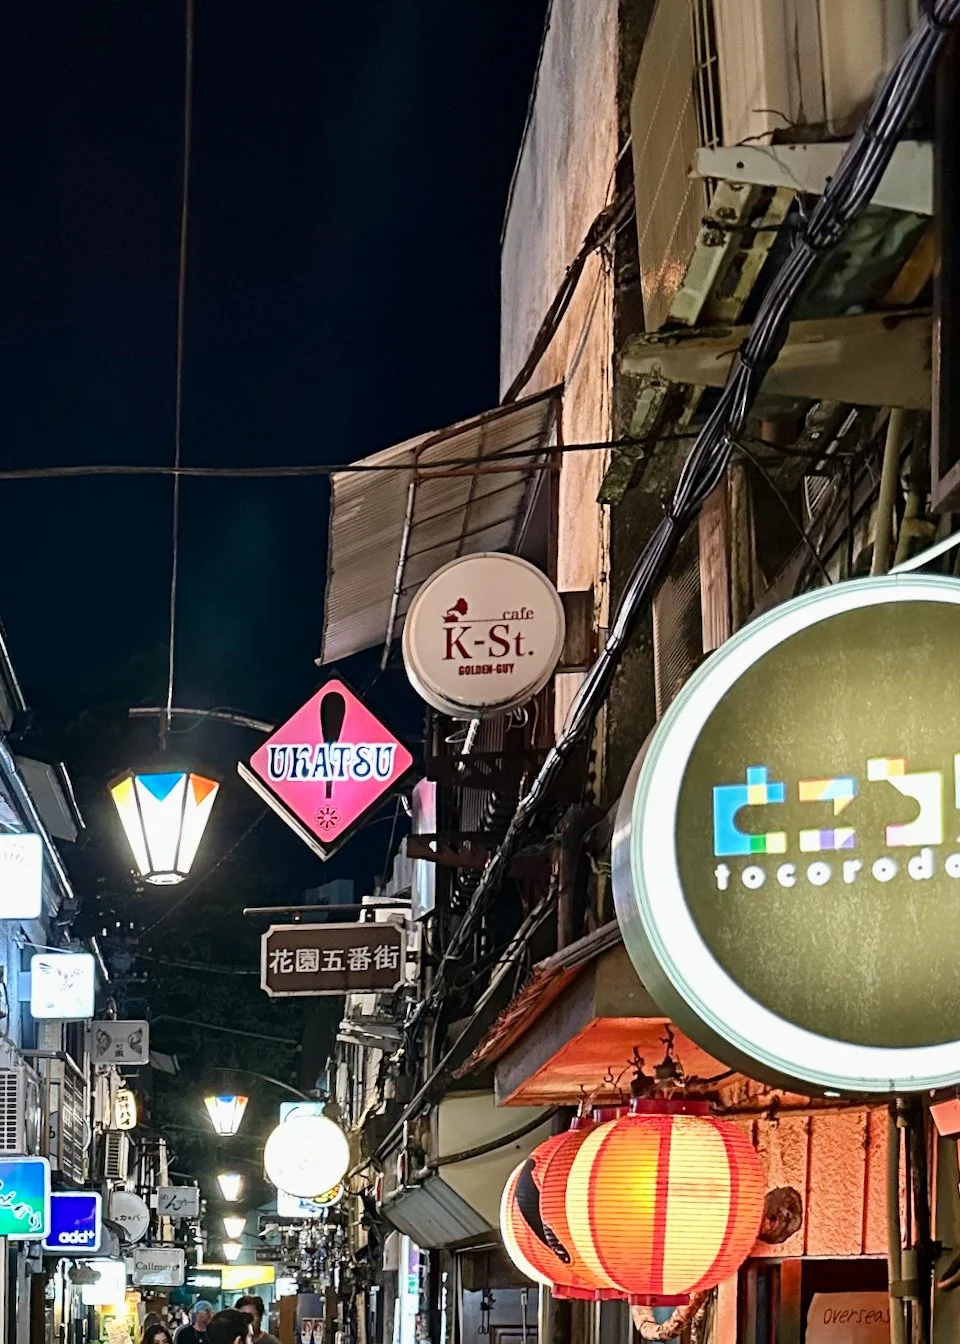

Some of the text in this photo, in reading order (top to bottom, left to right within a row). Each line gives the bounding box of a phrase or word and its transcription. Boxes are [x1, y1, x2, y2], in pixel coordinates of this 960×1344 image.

[503, 607, 534, 620] cafe
[441, 624, 534, 660] K-St.
[458, 663, 515, 676] GOLDEN-GUY
[268, 745, 395, 779] UKATSU
[268, 945, 400, 975] 花園五番街
